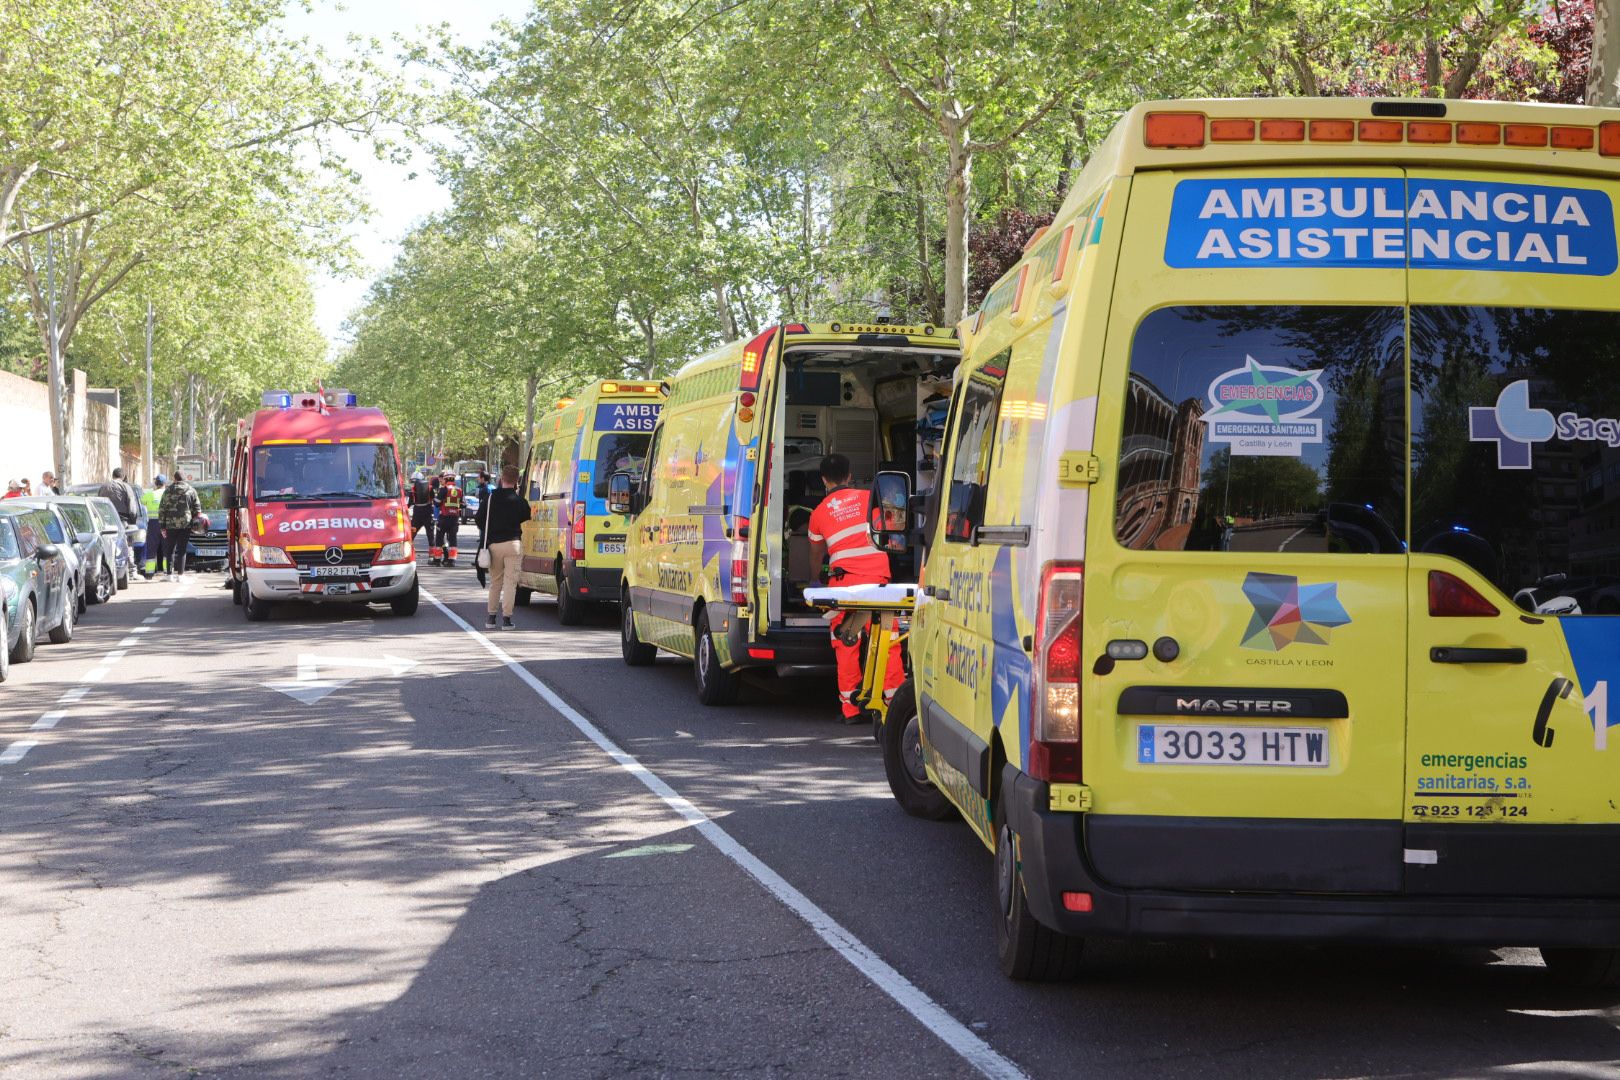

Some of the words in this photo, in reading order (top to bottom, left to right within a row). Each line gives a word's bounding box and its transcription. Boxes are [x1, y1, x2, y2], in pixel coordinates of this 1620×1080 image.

[1198, 187, 1591, 227] AMBULANCIA
[1195, 227, 1588, 266] ASISTENCIAL
[1219, 384, 1314, 401] EMERGENCIAS
[613, 418, 657, 430] ASIS
[1216, 424, 1270, 435] EMERGENCIAS
[1271, 424, 1316, 435] SANITARIAS
[1238, 439, 1266, 448] Castilla
[604, 543, 626, 554] 665
[316, 567, 339, 577] 6782
[1246, 658, 1294, 666] CASTILLA
[1176, 698, 1293, 714] MASTER
[1162, 730, 1247, 761] 3033
[1261, 731, 1324, 763] HTW
[1421, 751, 1528, 772] emergencias
[1417, 773, 1500, 793] sanitarias,
[1504, 776, 1532, 790] s.a.
[1431, 805, 1461, 817] 923
[1500, 805, 1529, 817] 124
